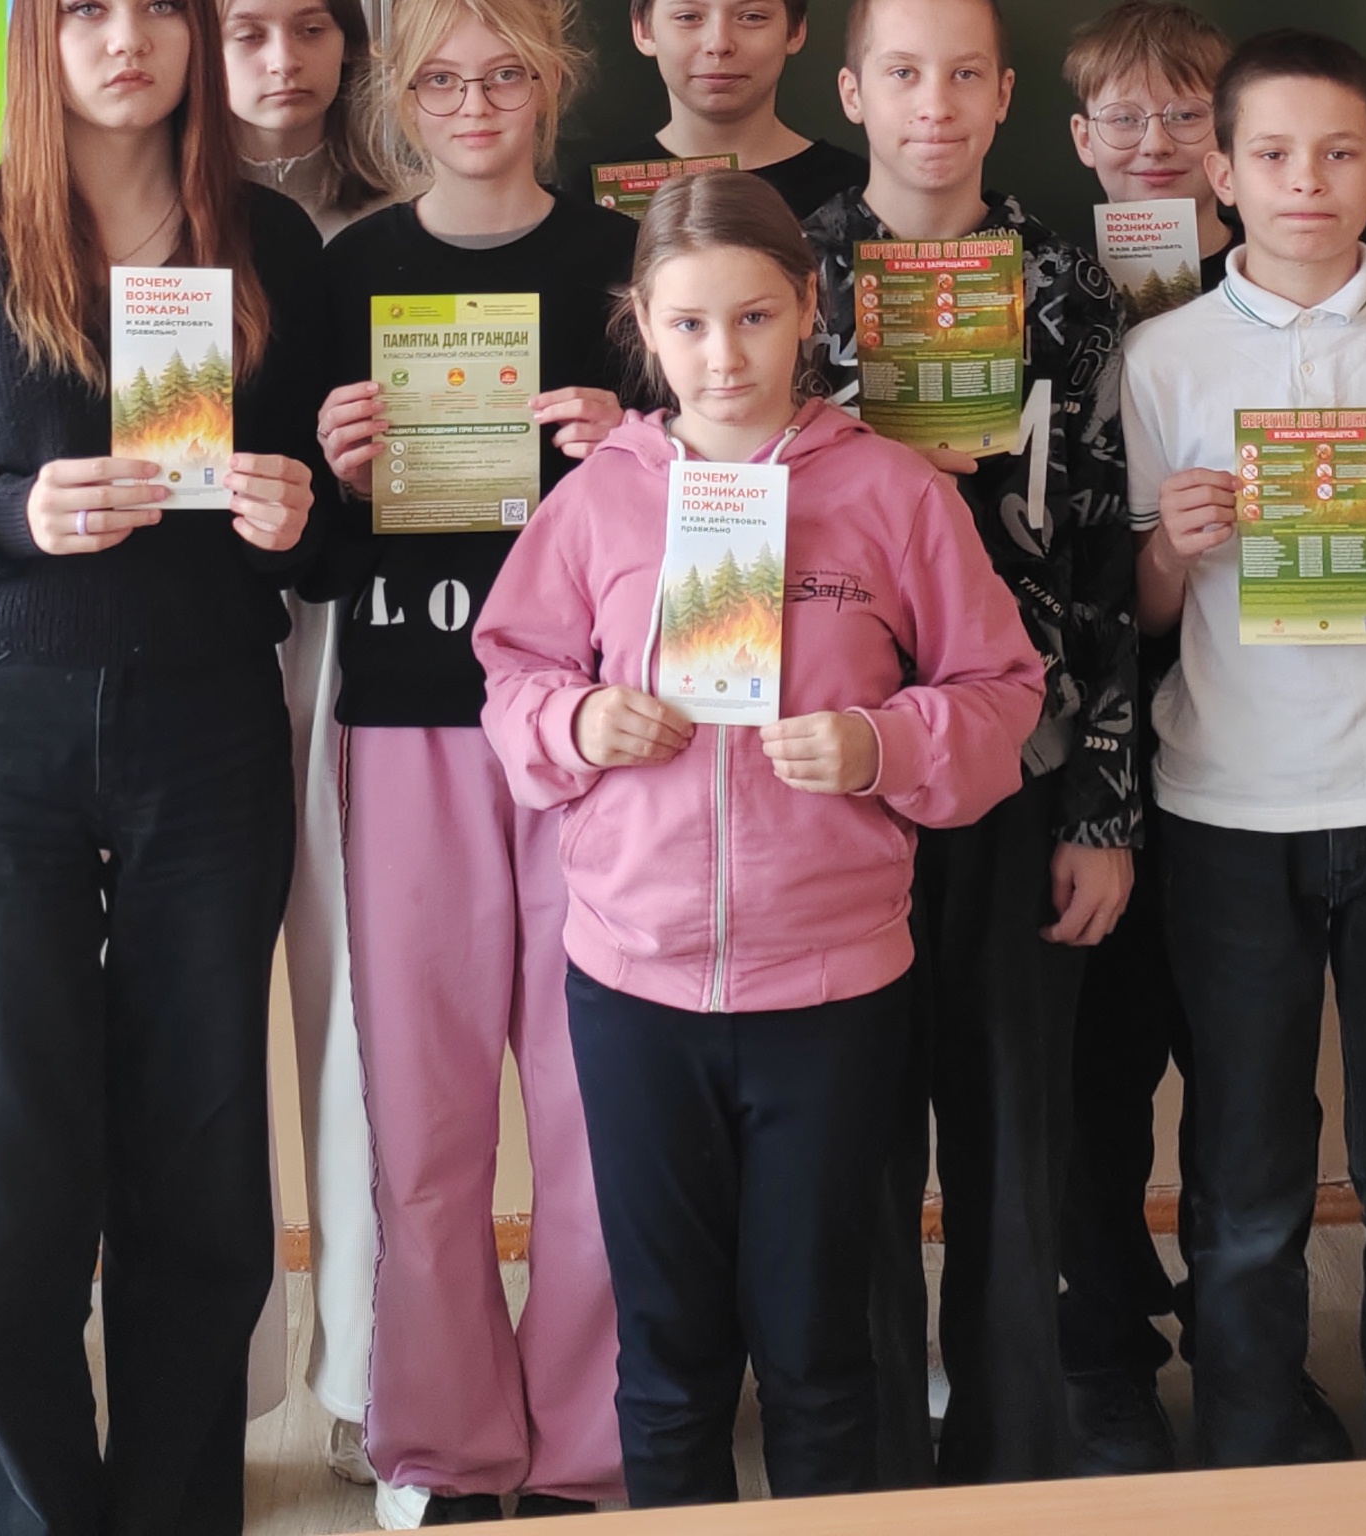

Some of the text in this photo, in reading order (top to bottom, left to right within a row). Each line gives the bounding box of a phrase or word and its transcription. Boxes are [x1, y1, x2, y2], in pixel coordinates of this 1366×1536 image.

[1106, 213, 1154, 221] ПОЧЕМУ
[1107, 222, 1180, 232] ВОЗНИКАЮТ
[1107, 234, 1162, 243] ПОЖАРЫ
[126, 277, 182, 287] ПОЧЕМУ
[126, 291, 212, 301] ВОЗНИКАЮТ
[126, 304, 189, 315] ПОЖАРЫ
[383, 331, 529, 348] ПАМЯТКА ДЛЯ ГРАЖДАН
[683, 472, 738, 483] ПОЧЕМУ
[683, 486, 767, 499] ВОЗНИКАЮТ
[682, 500, 744, 512] ПОЖАРЫ
